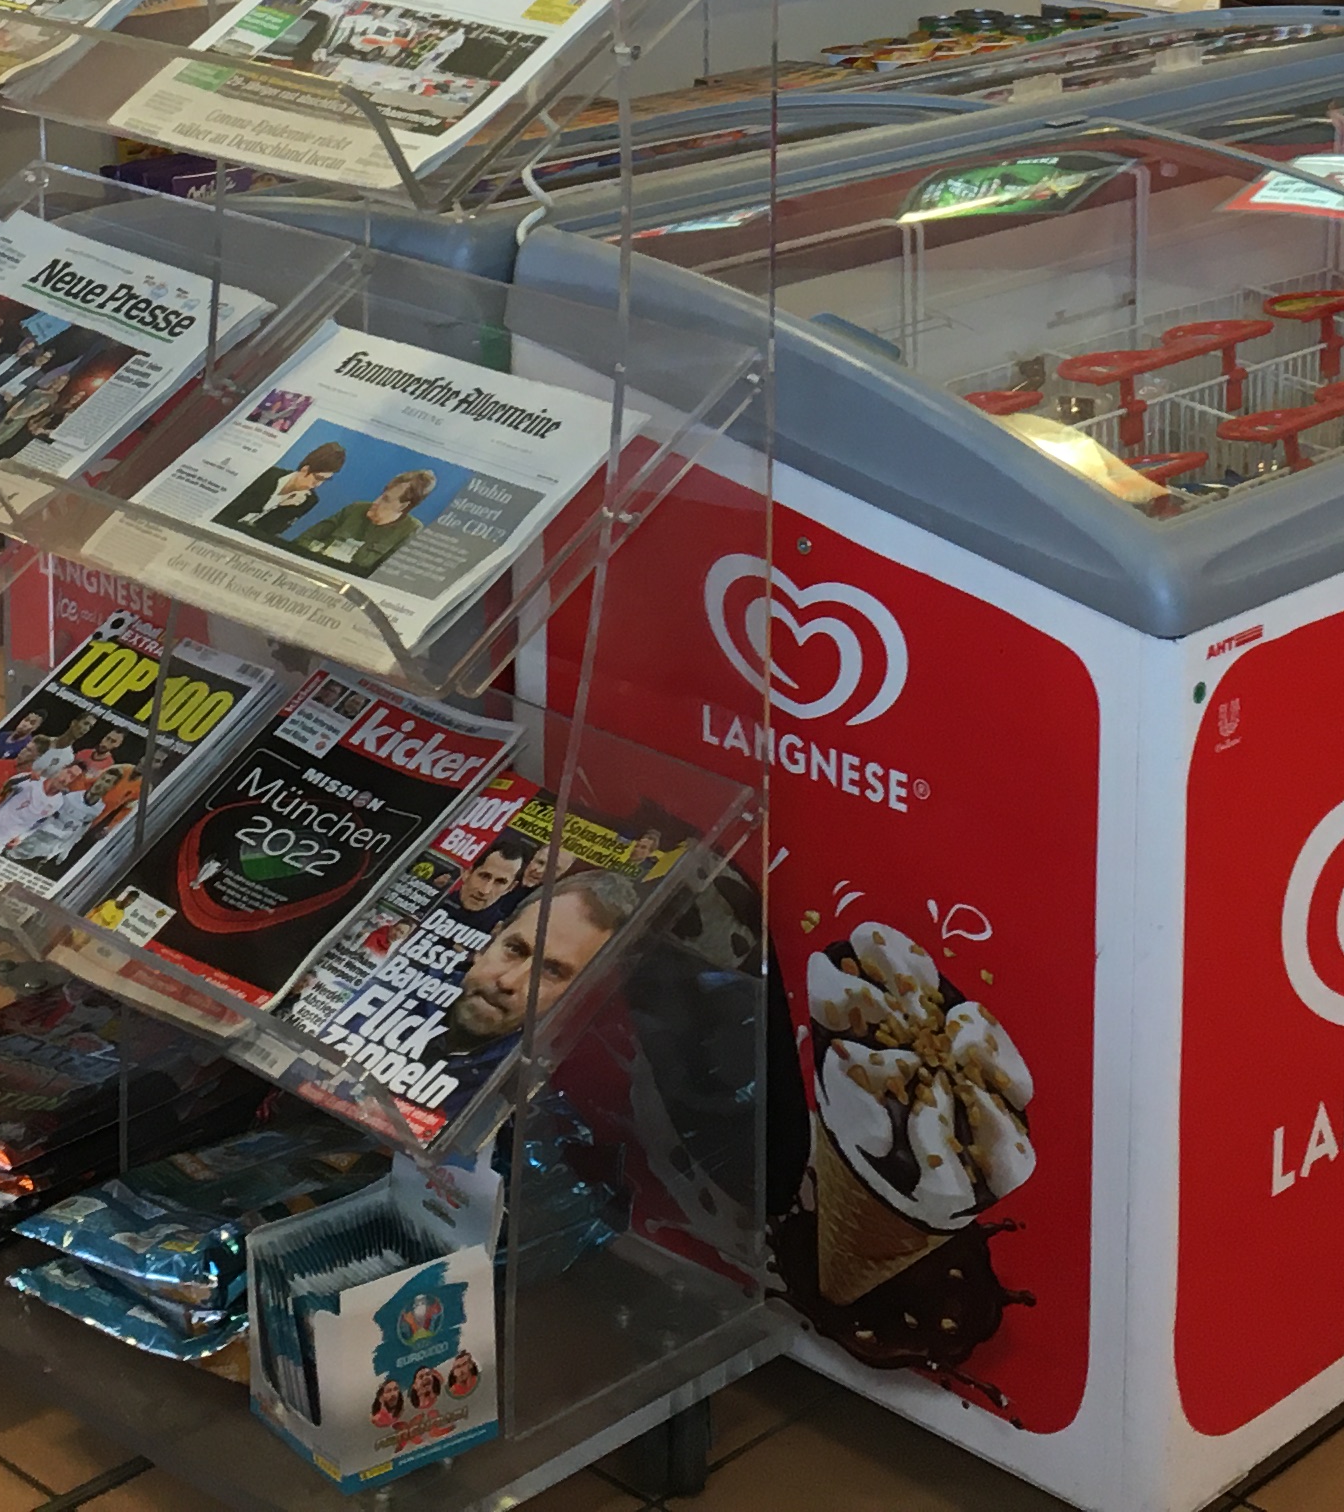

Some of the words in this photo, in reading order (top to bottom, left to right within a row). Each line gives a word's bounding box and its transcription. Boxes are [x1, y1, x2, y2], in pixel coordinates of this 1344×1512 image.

[27, 258, 110, 312] Neue
[96, 282, 198, 338] Presse
[451, 385, 564, 442] Allgemeine
[452, 496, 502, 522] steuert
[464, 476, 514, 505] Wohin
[436, 508, 466, 531] die
[462, 515, 508, 546] CDU?
[224, 551, 273, 582] Patient:
[167, 554, 192, 572] der
[307, 607, 343, 631] Euro
[59, 638, 161, 707] TOP
[133, 674, 235, 743] 100
[348, 706, 486, 784] kicker
[702, 703, 909, 814] LANGNESE
[237, 766, 392, 854] München
[302, 767, 386, 813] MISSION
[449, 795, 526, 832] port
[235, 815, 342, 877] 2022
[440, 827, 487, 862] Bild
[511, 816, 555, 844] zwische
[398, 929, 469, 974] lässt
[420, 908, 492, 951] Darum
[376, 957, 464, 1008] Bayern
[332, 983, 450, 1061] Flick
